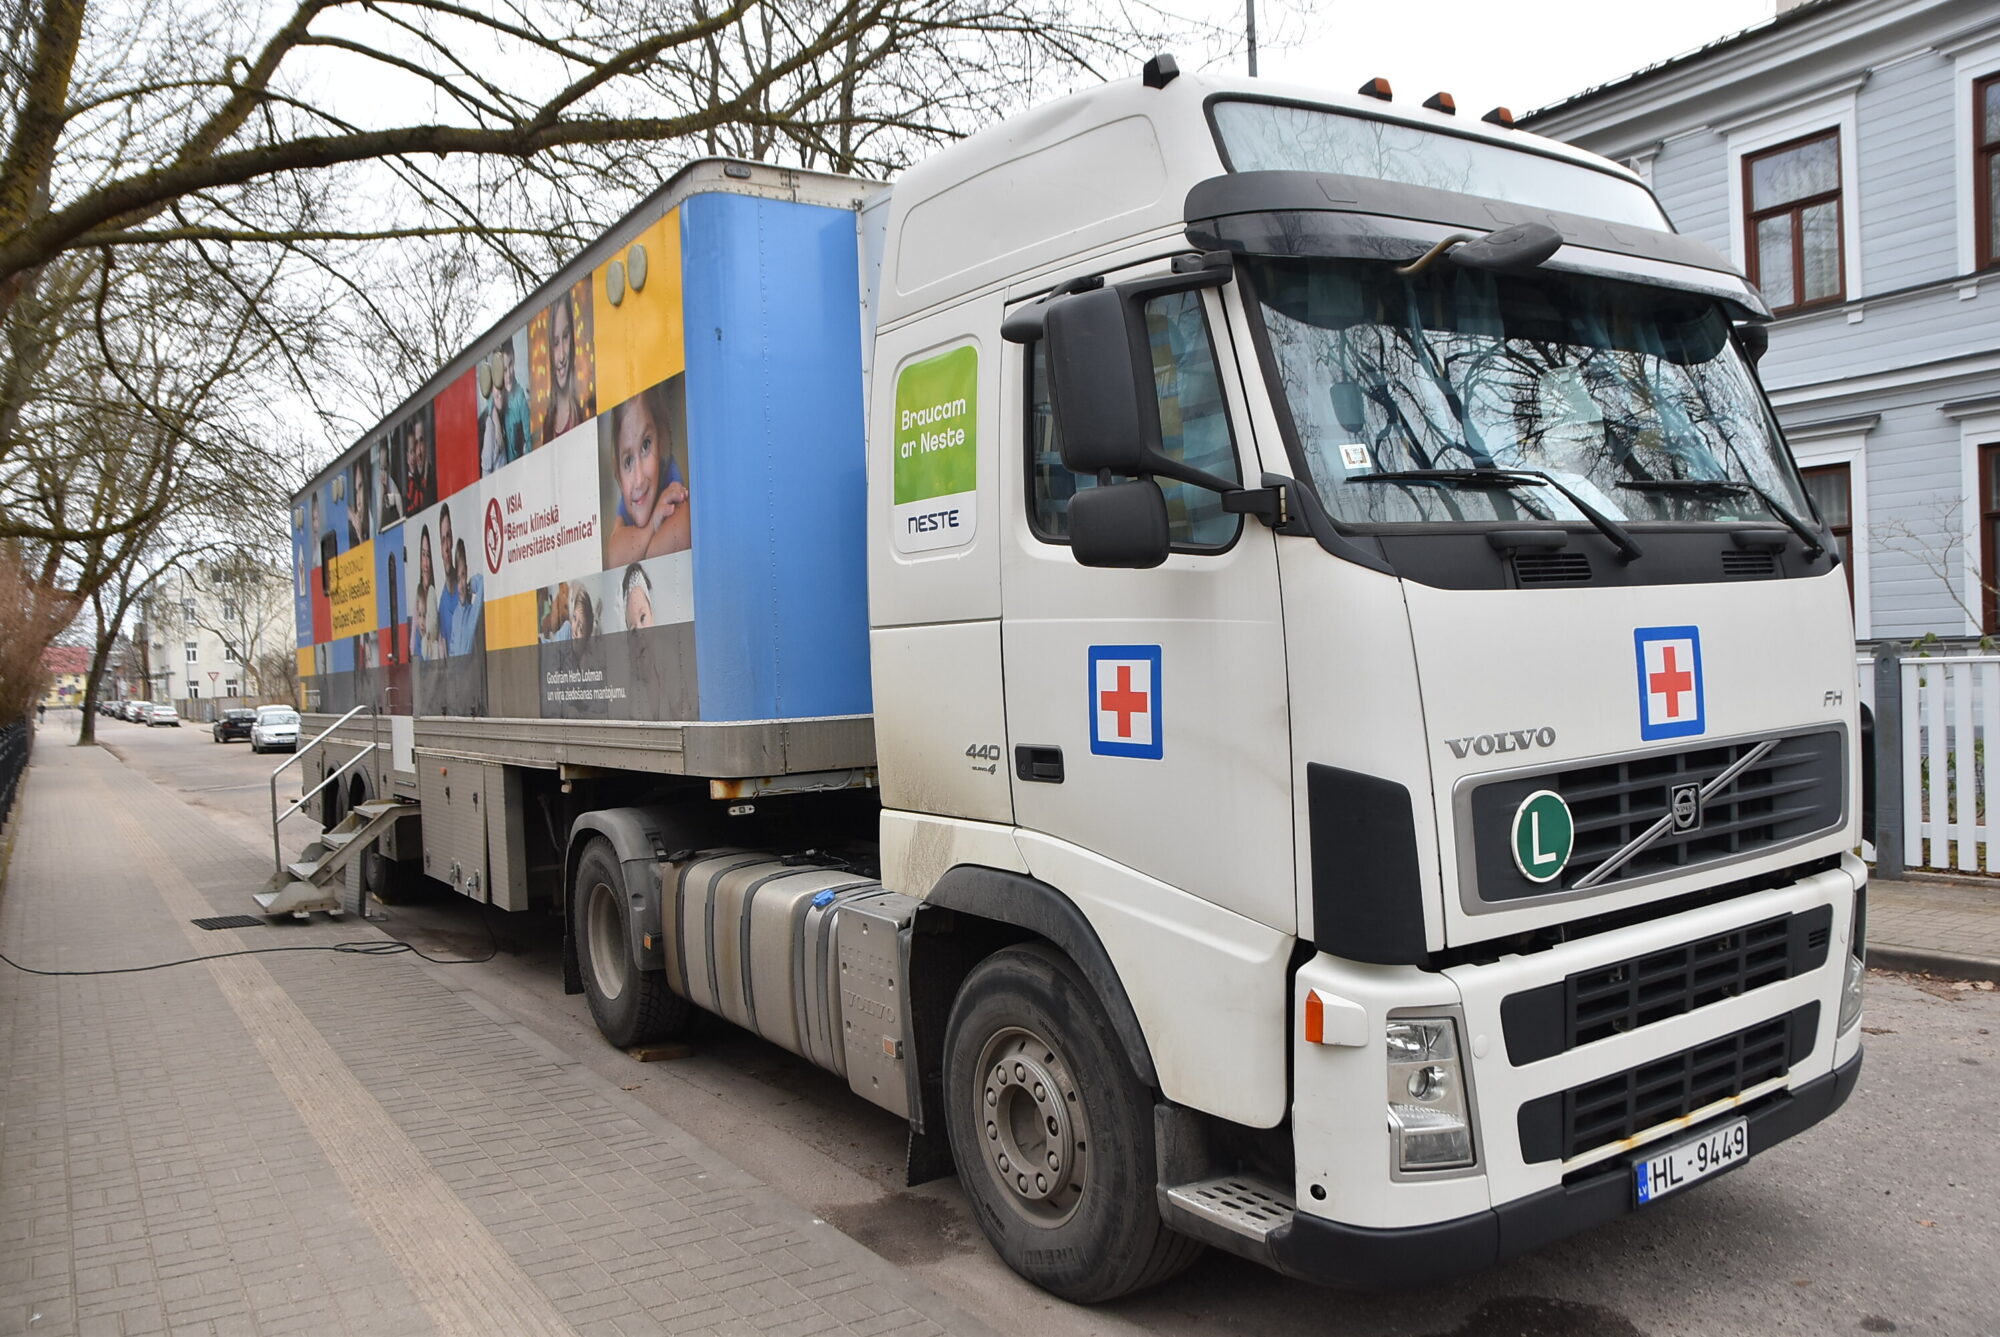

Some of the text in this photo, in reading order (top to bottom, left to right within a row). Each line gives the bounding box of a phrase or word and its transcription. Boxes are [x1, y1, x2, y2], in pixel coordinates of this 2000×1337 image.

[901, 398, 966, 431] Braucam
[901, 427, 965, 459] ar Neste
[506, 492, 522, 515] VSIA
[908, 509, 960, 535] NESTE
[507, 535, 556, 563] universitātes
[1823, 690, 1842, 707] FH
[965, 743, 1001, 761] 440
[1444, 726, 1556, 760] VOLVO
[1531, 811, 1557, 865] L
[843, 988, 896, 1024] VOLVO
[1637, 1184, 1648, 1197] LV
